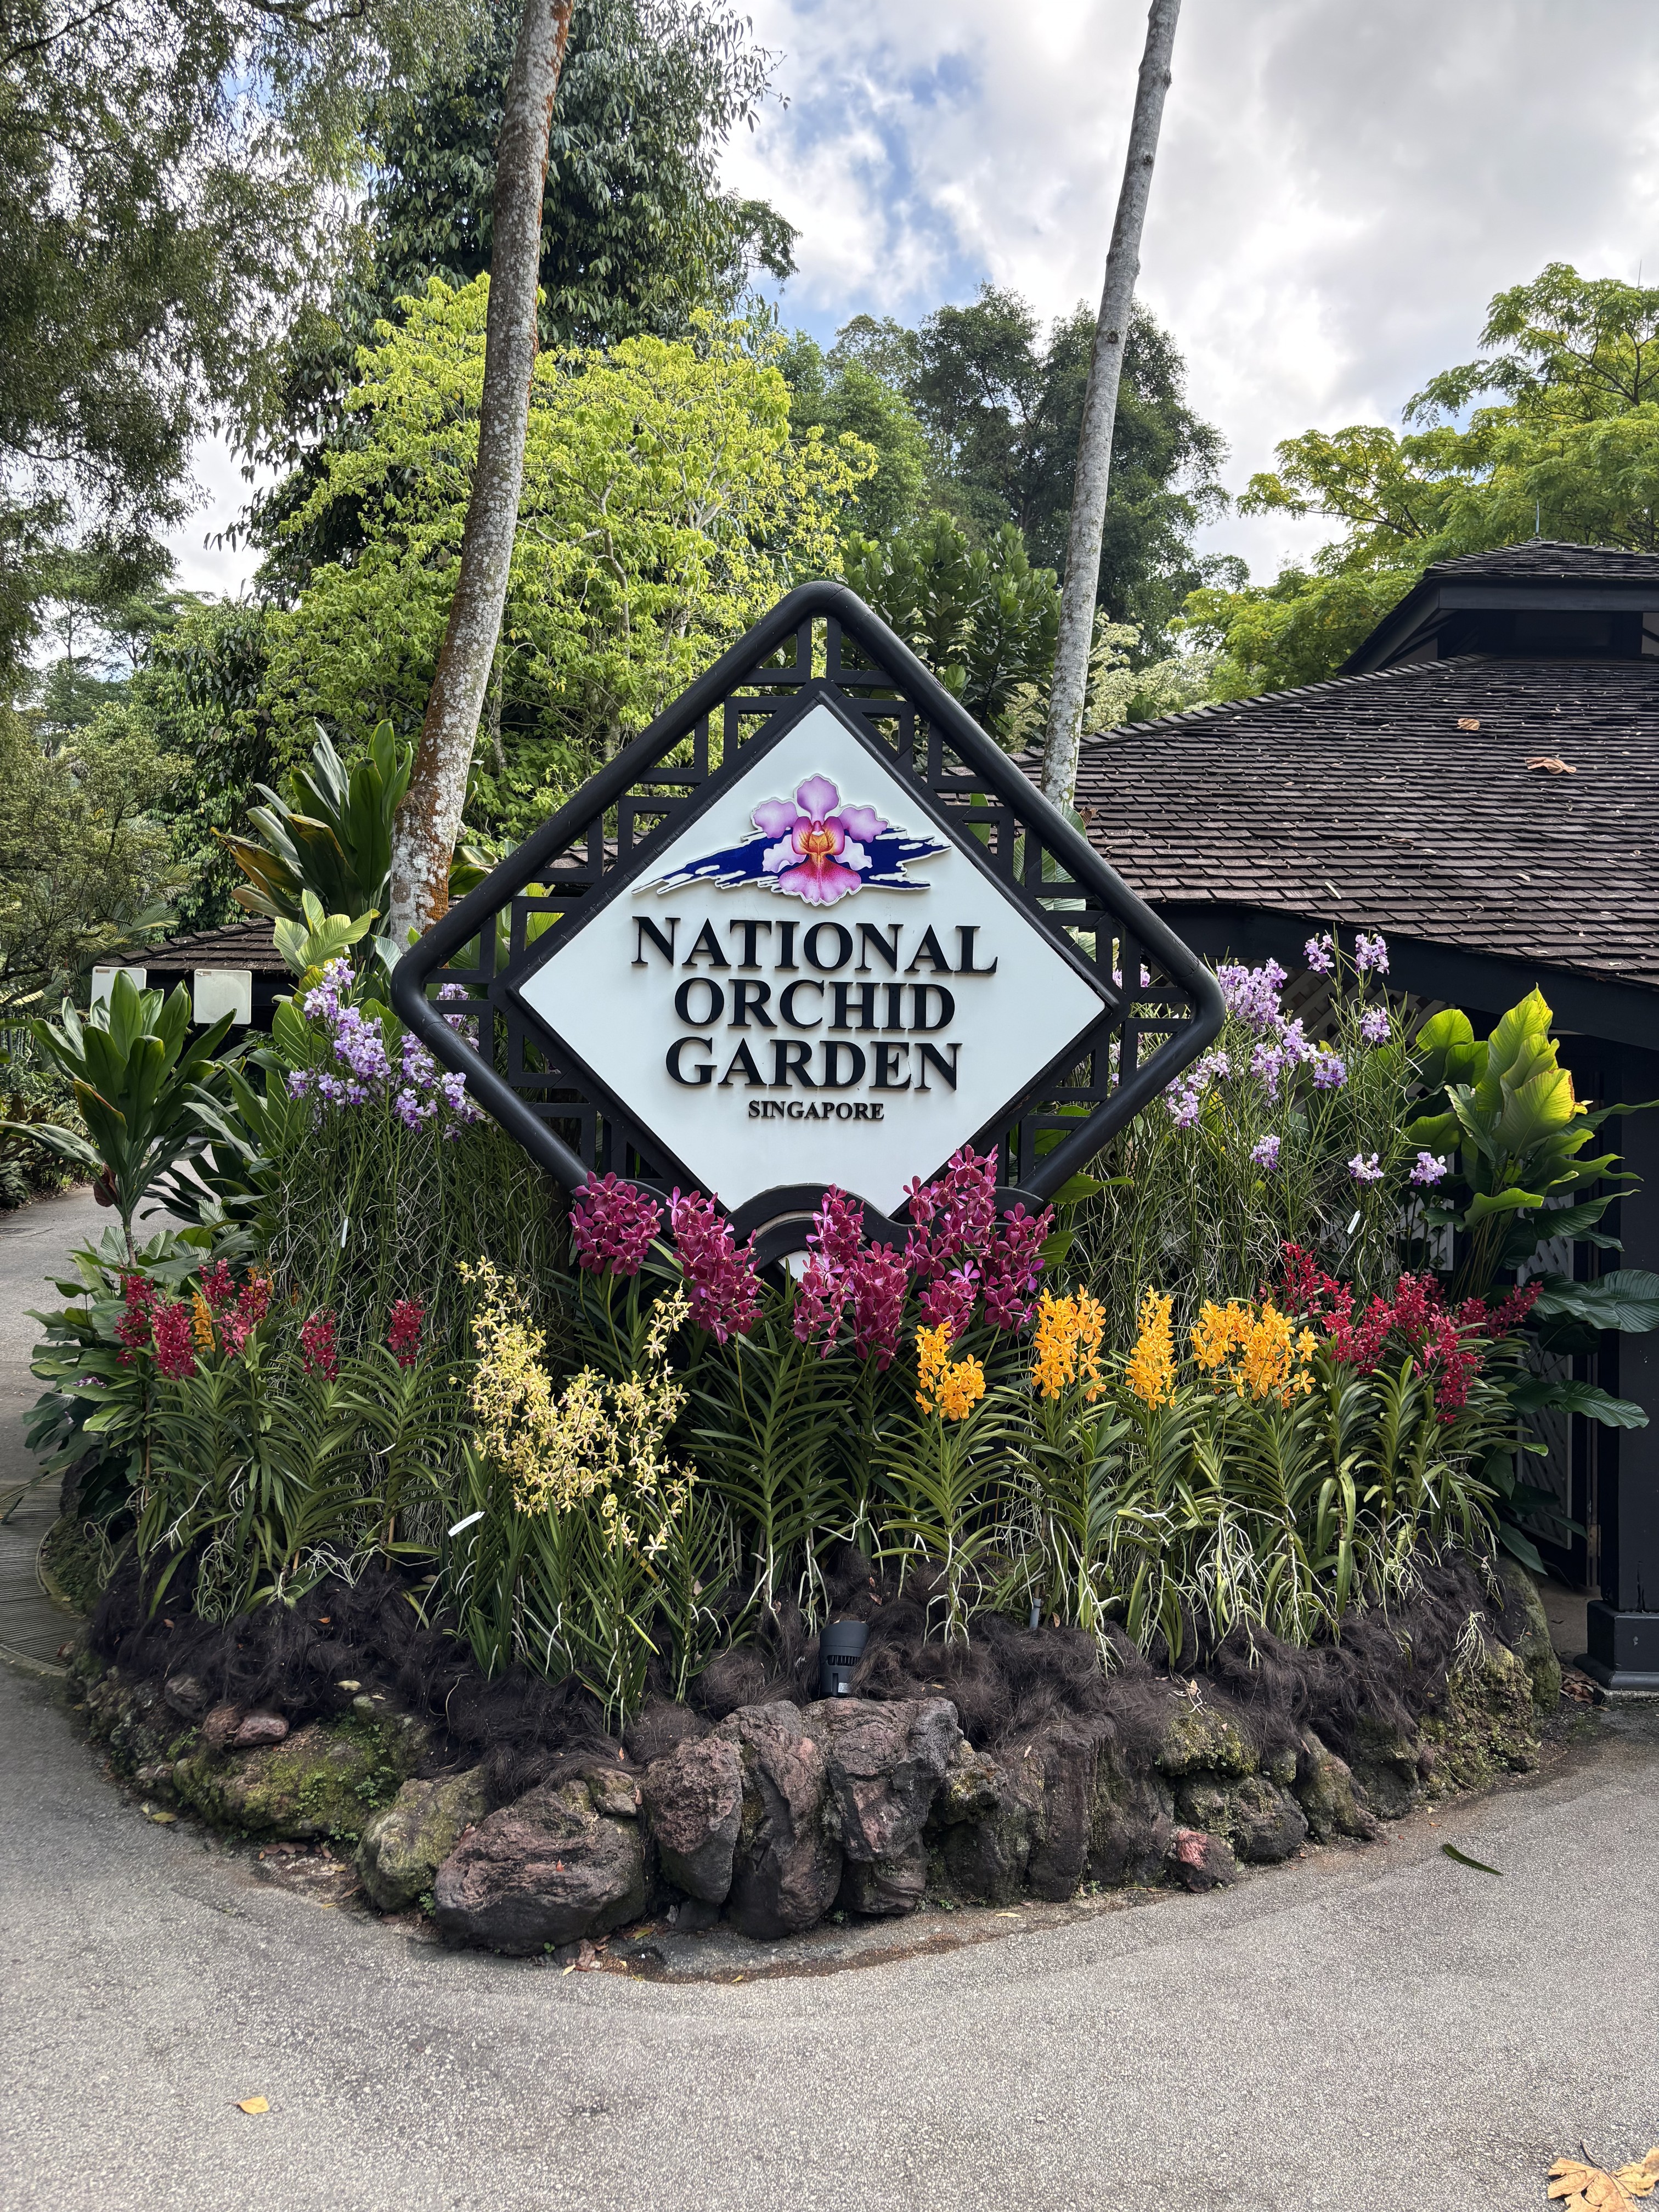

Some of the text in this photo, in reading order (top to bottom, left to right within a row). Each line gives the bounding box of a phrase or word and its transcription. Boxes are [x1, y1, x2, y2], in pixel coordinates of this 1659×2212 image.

[631, 916, 998, 974] NATIONAL
[674, 977, 956, 1031] ORCHID
[665, 1036, 963, 1091] GARDEN
[748, 1100, 884, 1120] SINGAPORE
